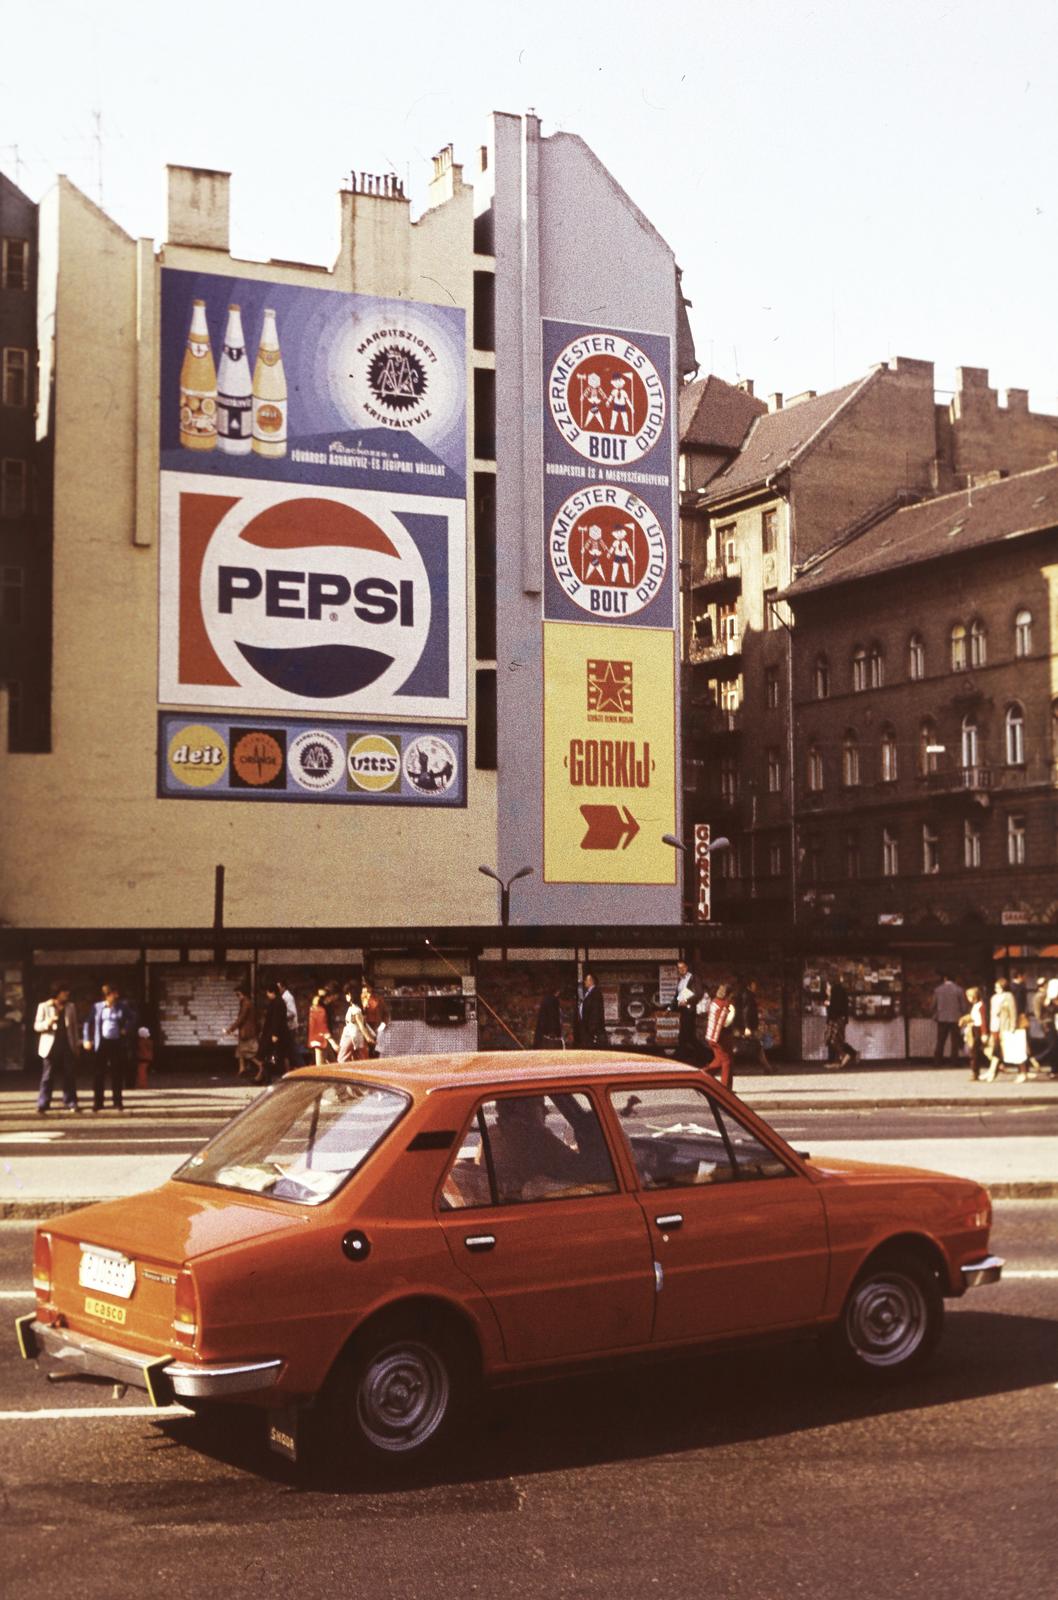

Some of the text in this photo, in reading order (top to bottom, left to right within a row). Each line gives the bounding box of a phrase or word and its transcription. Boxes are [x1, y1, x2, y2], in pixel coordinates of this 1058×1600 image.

[357, 329, 437, 363] MARGITSZIGETI
[552, 337, 615, 442] EZERMESTER
[589, 435, 627, 461] BOLT
[598, 468, 604, 479] A
[552, 488, 616, 596] EZERMESTER
[218, 565, 414, 627] PEPSI
[590, 588, 628, 613] BOLT
[173, 744, 222, 766] deit
